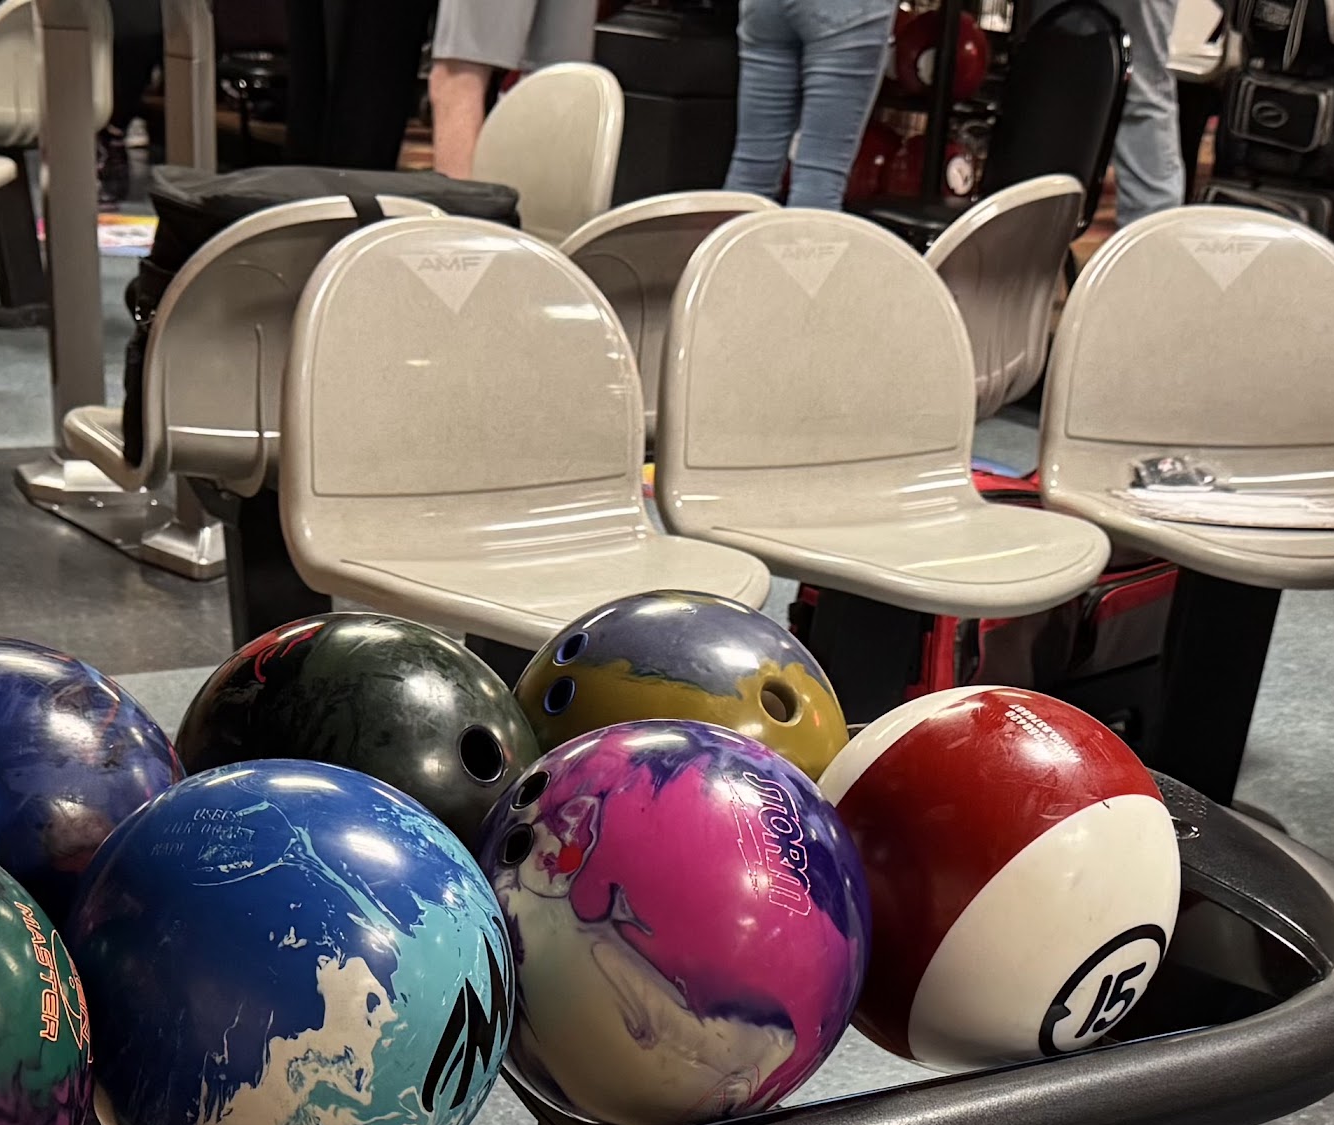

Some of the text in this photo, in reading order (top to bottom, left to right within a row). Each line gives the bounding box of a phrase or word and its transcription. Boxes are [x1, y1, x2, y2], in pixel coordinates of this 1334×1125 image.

[417, 256, 483, 272] AMF
[780, 245, 835, 260] AMF
[1194, 241, 1261, 255] AMF
[743, 772, 812, 916] STORM
[14, 901, 60, 1042] MASTER
[1074, 961, 1147, 1039] 15
